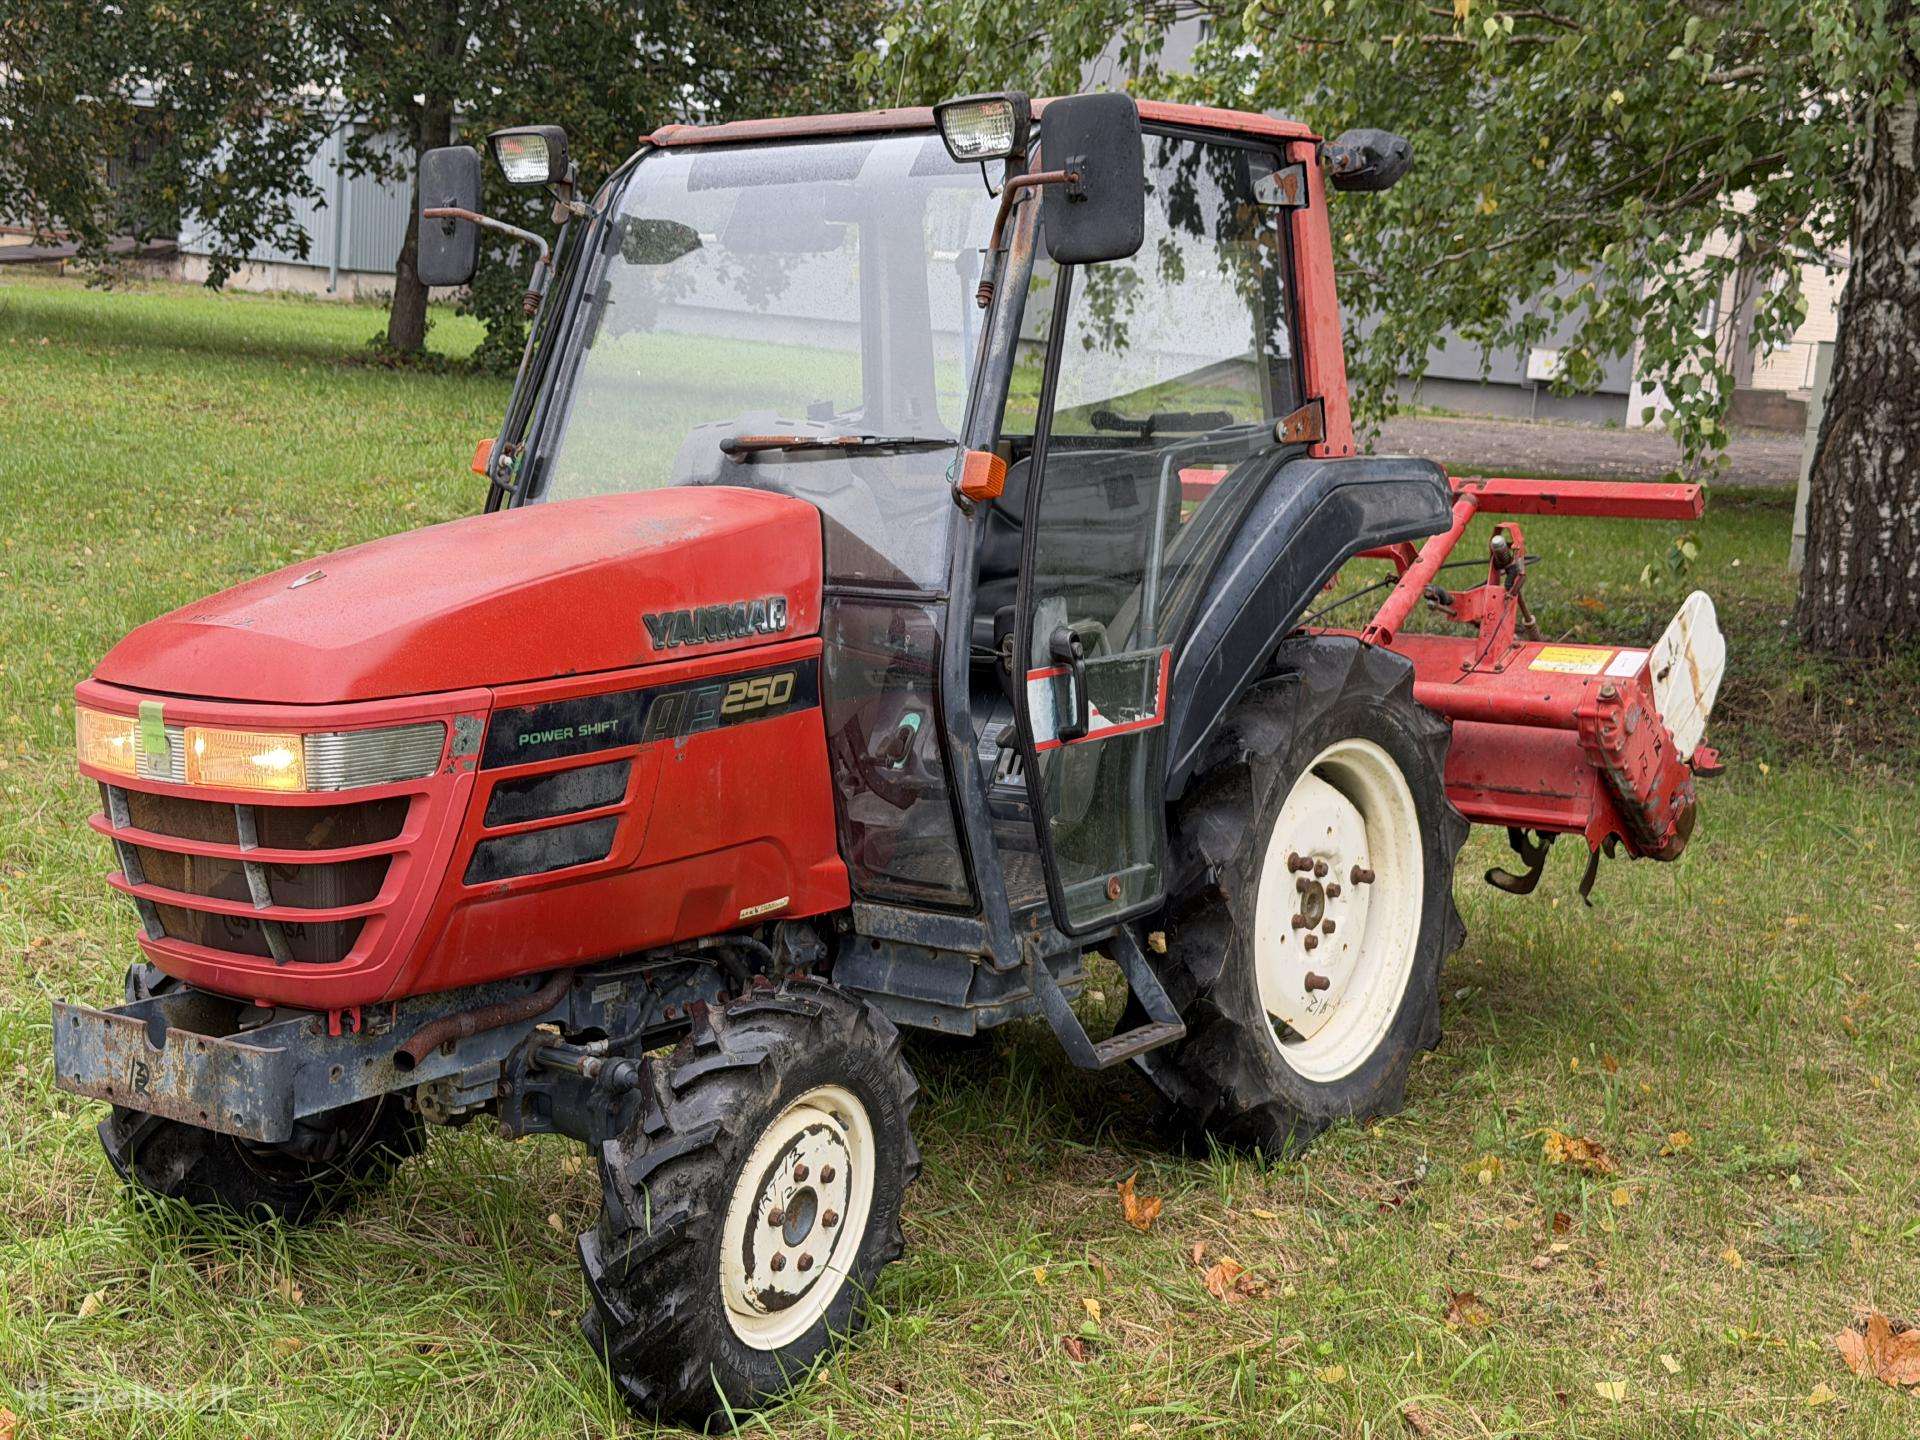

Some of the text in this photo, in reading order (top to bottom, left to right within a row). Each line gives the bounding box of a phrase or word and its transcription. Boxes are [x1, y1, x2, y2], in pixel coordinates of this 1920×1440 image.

[642, 595, 787, 651] YANMAR
[519, 719, 620, 747] POWER SHIFT
